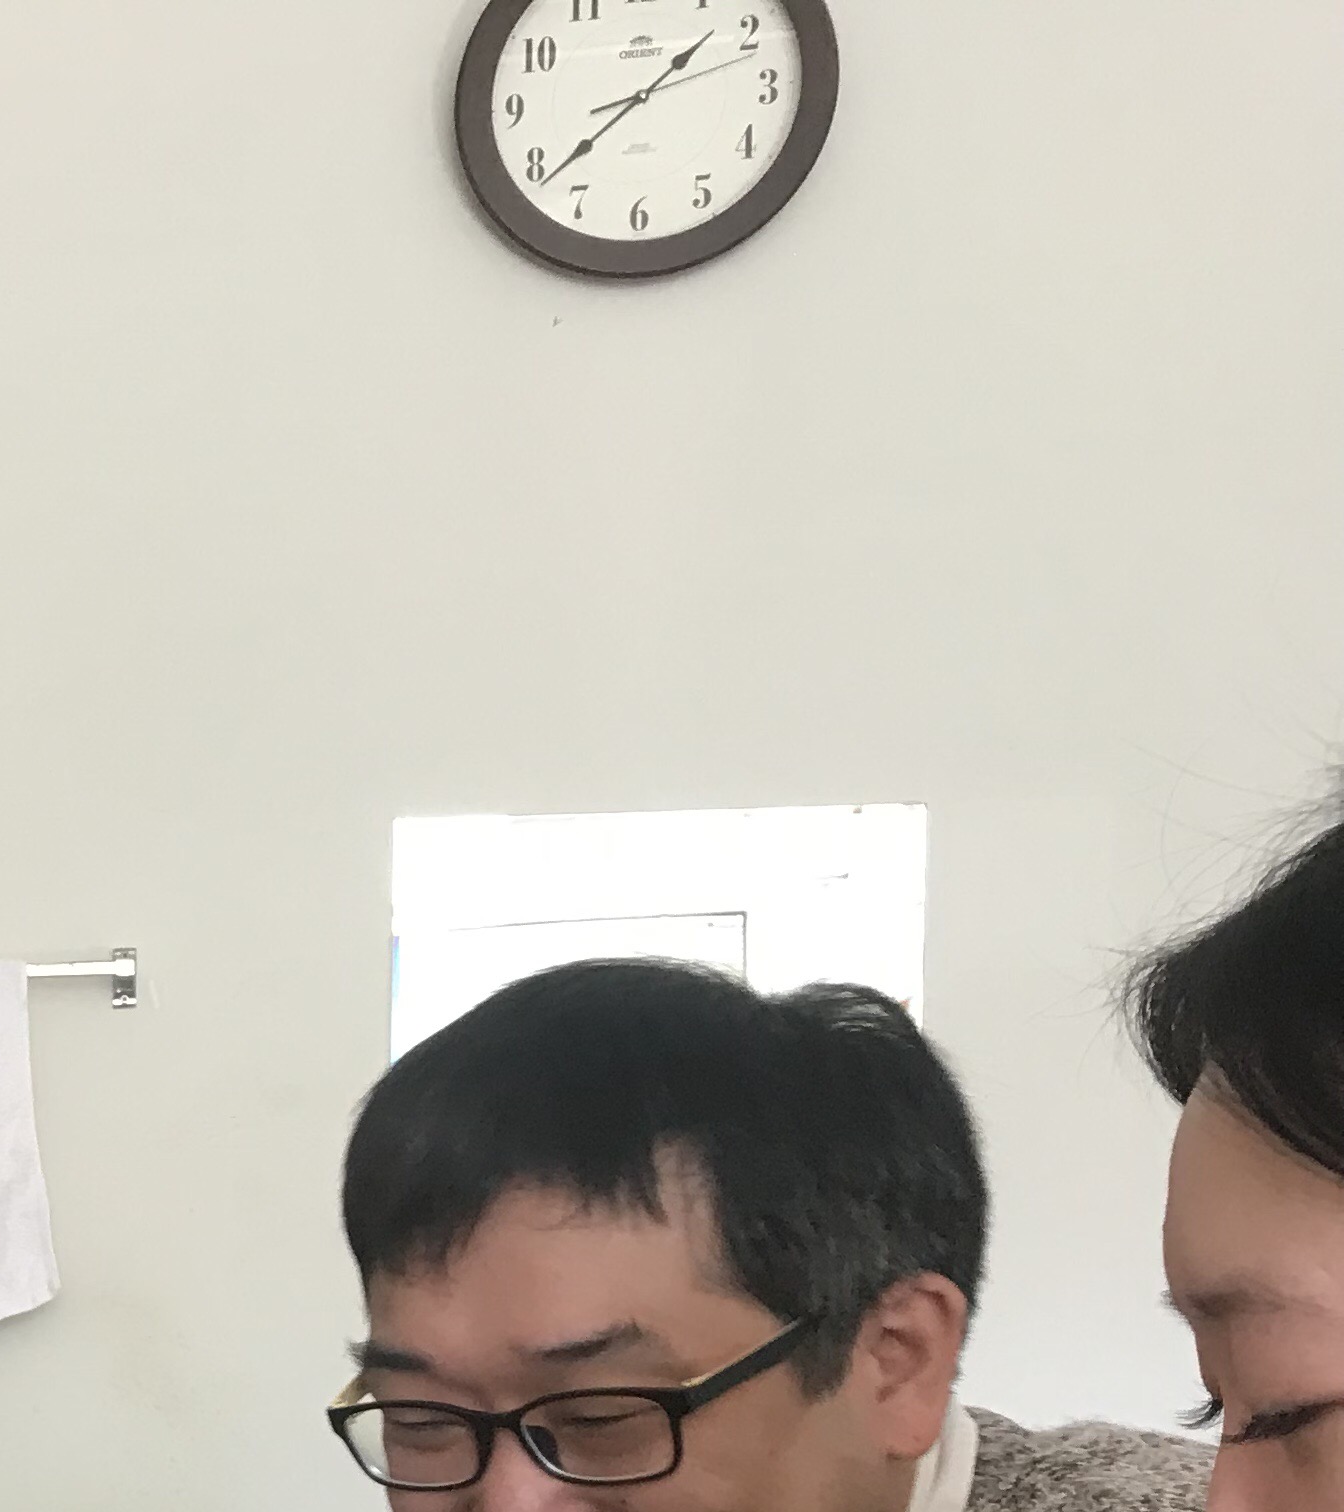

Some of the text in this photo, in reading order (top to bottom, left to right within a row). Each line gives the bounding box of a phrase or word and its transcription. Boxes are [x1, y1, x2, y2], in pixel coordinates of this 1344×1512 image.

[739, 14, 760, 51] 2
[521, 36, 557, 73] 10
[619, 46, 664, 59] ORIENT
[758, 68, 779, 105] 3
[505, 93, 525, 129] 9
[735, 124, 756, 160] 4
[526, 147, 545, 183] 8
[569, 184, 589, 220] 7
[692, 173, 712, 209] 5
[629, 196, 649, 231] 6
